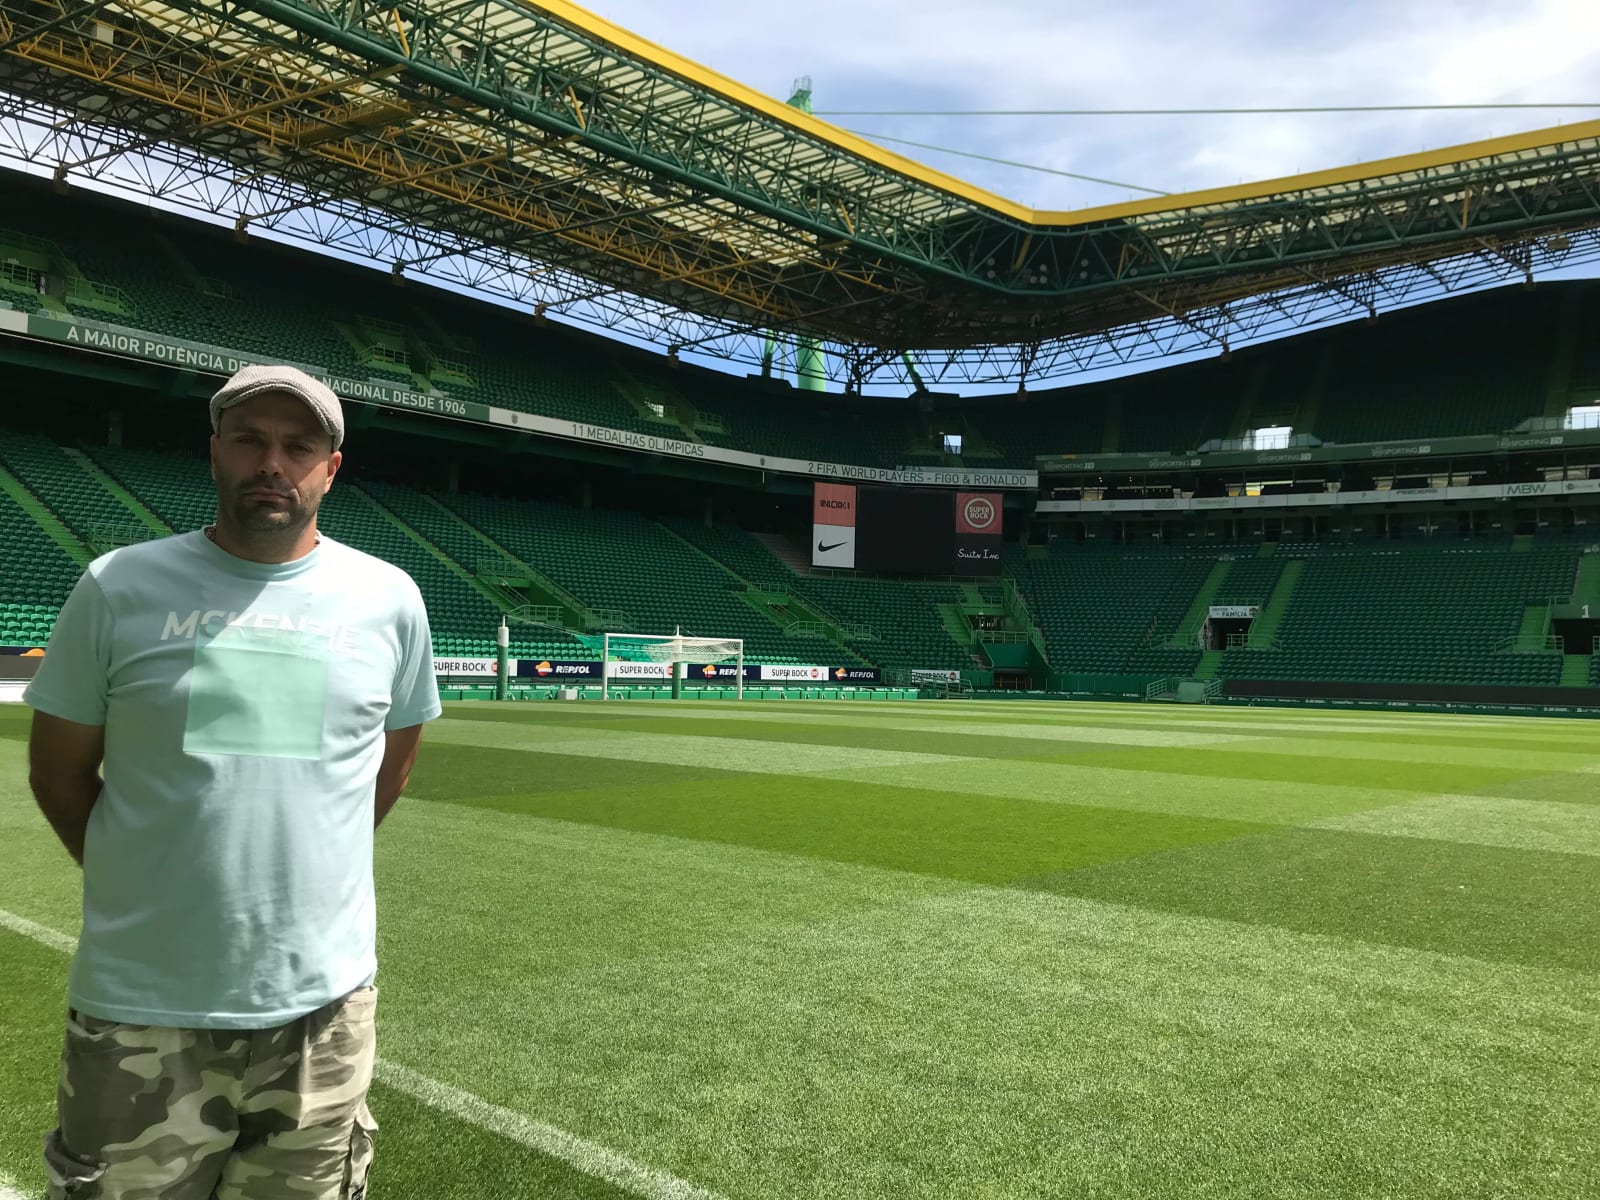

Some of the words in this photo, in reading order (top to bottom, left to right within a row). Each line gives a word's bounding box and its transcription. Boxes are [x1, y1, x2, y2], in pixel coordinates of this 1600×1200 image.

[67, 325, 80, 342] A
[84, 328, 140, 354] MAIOR
[144, 341, 224, 371] POTÊNCIA
[322, 376, 390, 407] NACIONAL
[393, 390, 435, 410] DESDE
[438, 398, 467, 416] 1906
[572, 423, 584, 437] 11
[587, 426, 646, 448] MEDALHAS
[648, 437, 704, 457] OLÍMPICAS
[808, 462, 814, 473] 2
[817, 463, 838, 476] FIFA
[841, 465, 877, 479] WORLD
[879, 470, 924, 482] PLAYERS
[934, 473, 959, 484] FIGO
[962, 474, 970, 484] &
[974, 475, 1027, 486] RONALDO
[1506, 483, 1547, 495] MBW
[1581, 604, 1590, 619] 1
[433, 661, 460, 671] SUPER
[462, 662, 487, 672] BOCK
[555, 665, 590, 674] REPSOL
[619, 665, 643, 674] SUPER
[643, 666, 664, 675] BOCK
[719, 668, 748, 676] REPSL
[771, 668, 789, 677] SUPER
[791, 669, 808, 678] BOCK
[849, 671, 875, 679] REPSOL
